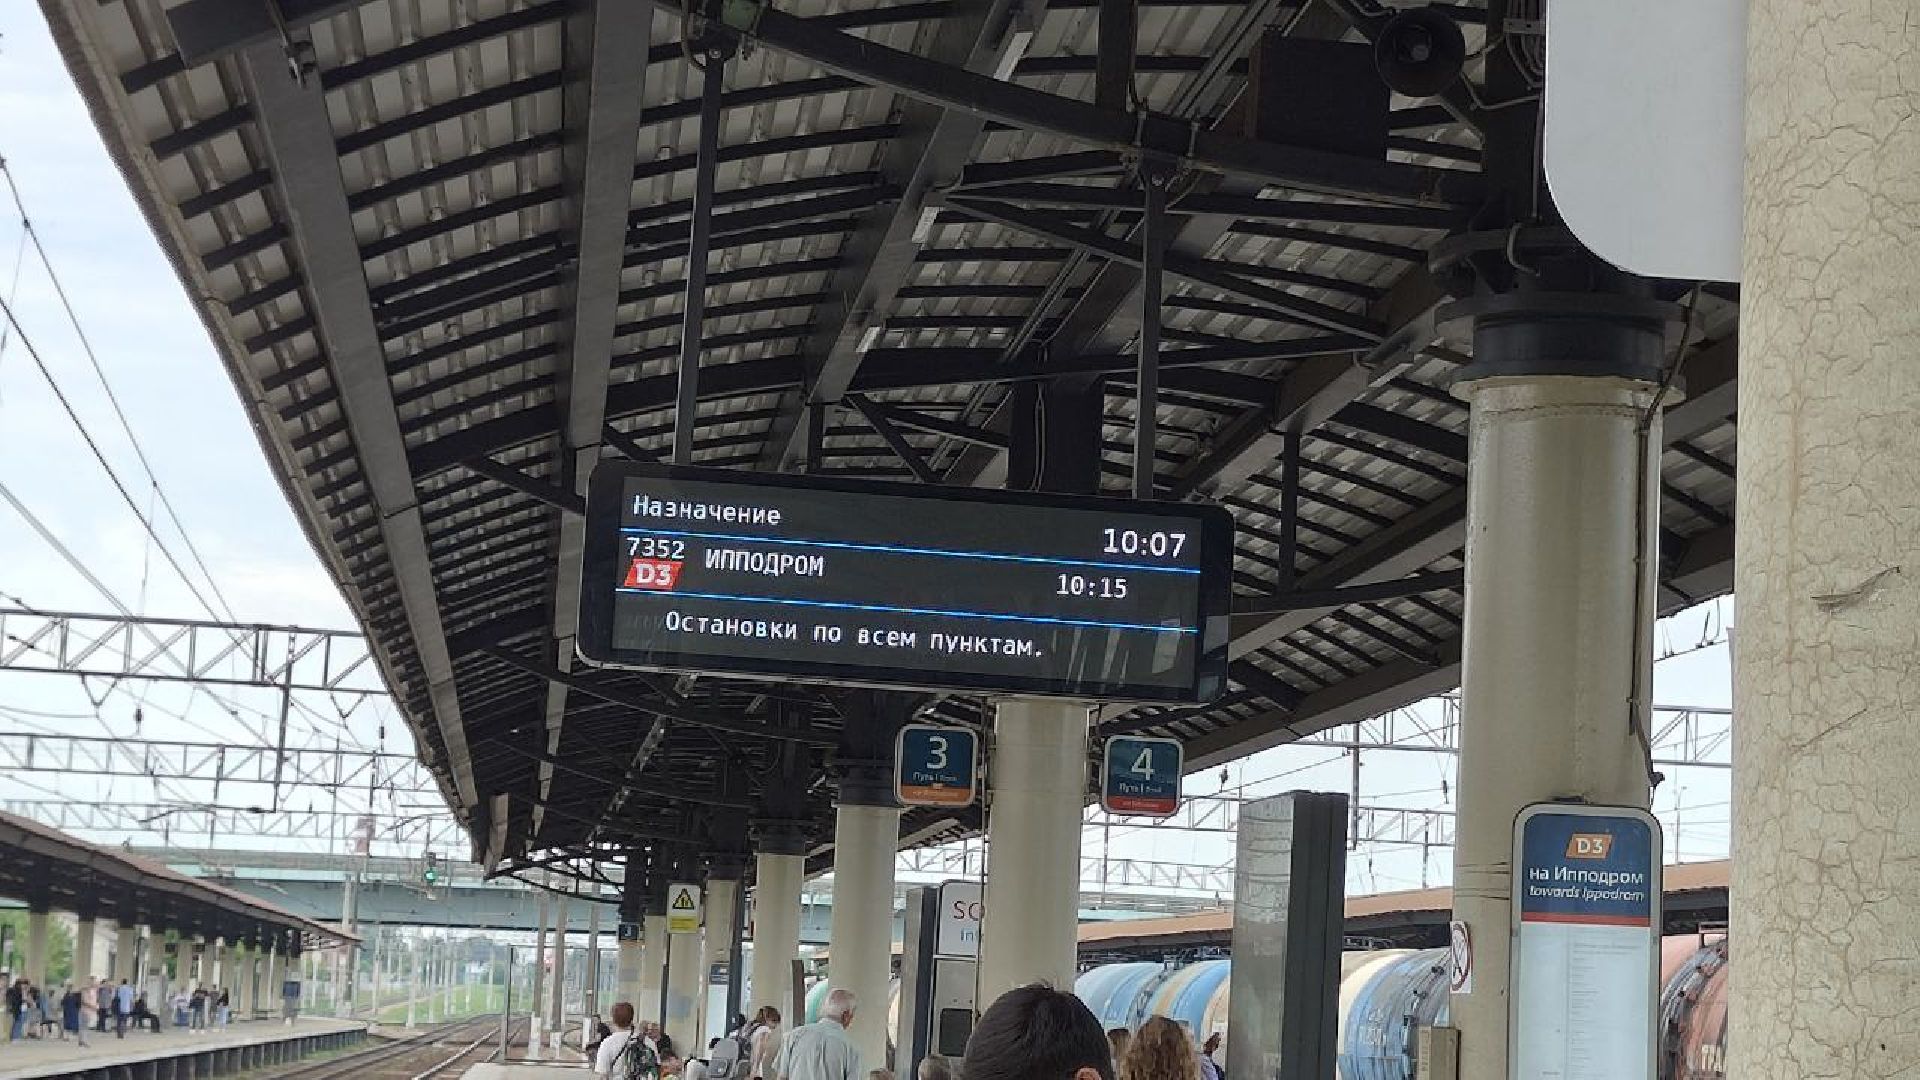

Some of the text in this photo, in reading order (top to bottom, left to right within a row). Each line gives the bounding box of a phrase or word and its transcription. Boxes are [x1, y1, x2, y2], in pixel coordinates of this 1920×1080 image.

[633, 495, 781, 526] Назначение
[626, 537, 686, 560] 7352
[1103, 528, 1187, 559] 10:07
[635, 562, 673, 587] D3
[705, 548, 825, 577] ИППОДРОМ
[1056, 573, 1128, 599] 10:15
[665, 611, 1043, 659] Остановки по всем пунктам.
[926, 735, 948, 770] 3
[1131, 747, 1156, 781] 4
[1577, 837, 1604, 854] D3
[1529, 866, 1644, 887] на Ипподром
[1529, 884, 1581, 899] towards
